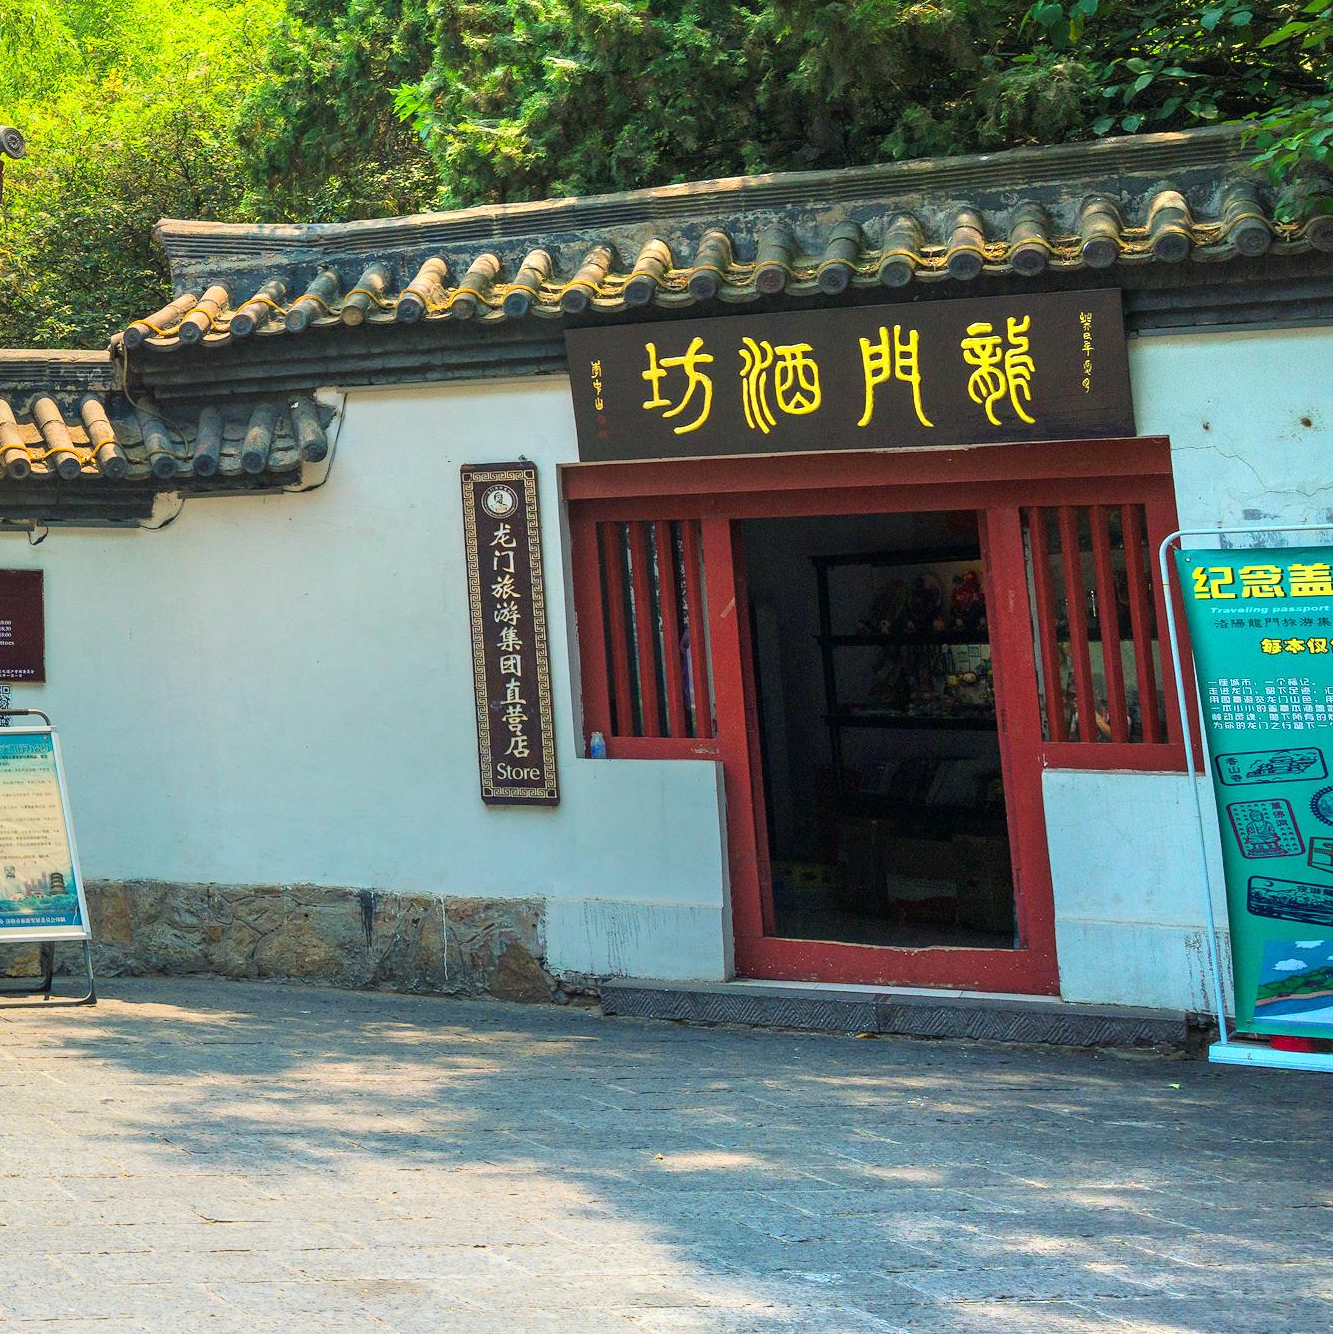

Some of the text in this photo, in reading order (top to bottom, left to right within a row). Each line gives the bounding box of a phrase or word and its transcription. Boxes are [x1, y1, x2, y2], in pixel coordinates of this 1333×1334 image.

[1210, 605, 1330, 615] Traveling passport
[489, 522, 531, 758] 龙门旅游集团直营店
[1260, 637, 1333, 655] 每本仅
[496, 762, 541, 782] Store
